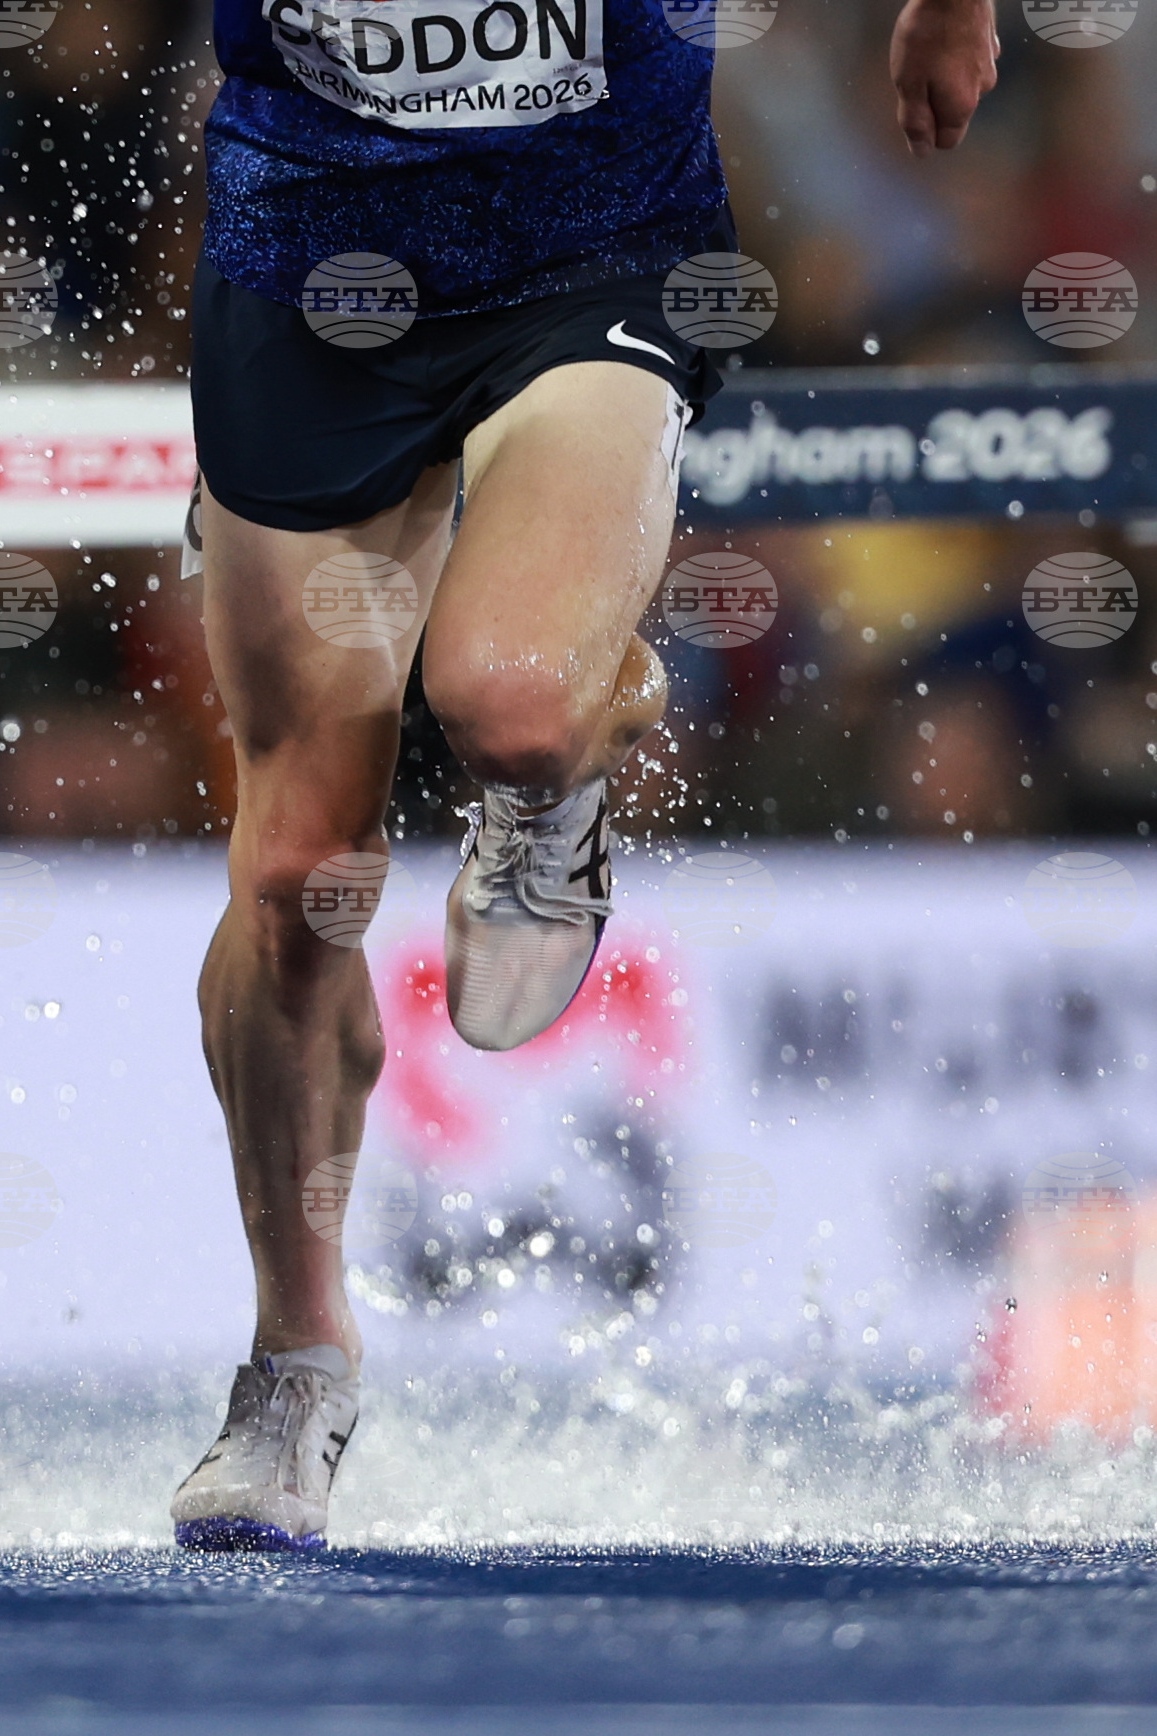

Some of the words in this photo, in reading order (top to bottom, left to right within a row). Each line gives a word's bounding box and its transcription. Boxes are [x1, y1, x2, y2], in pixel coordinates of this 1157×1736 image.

[294, 57, 506, 114] BIRMINGHAM
[514, 72, 592, 112] 2026
[922, 407, 1113, 481] 2026
